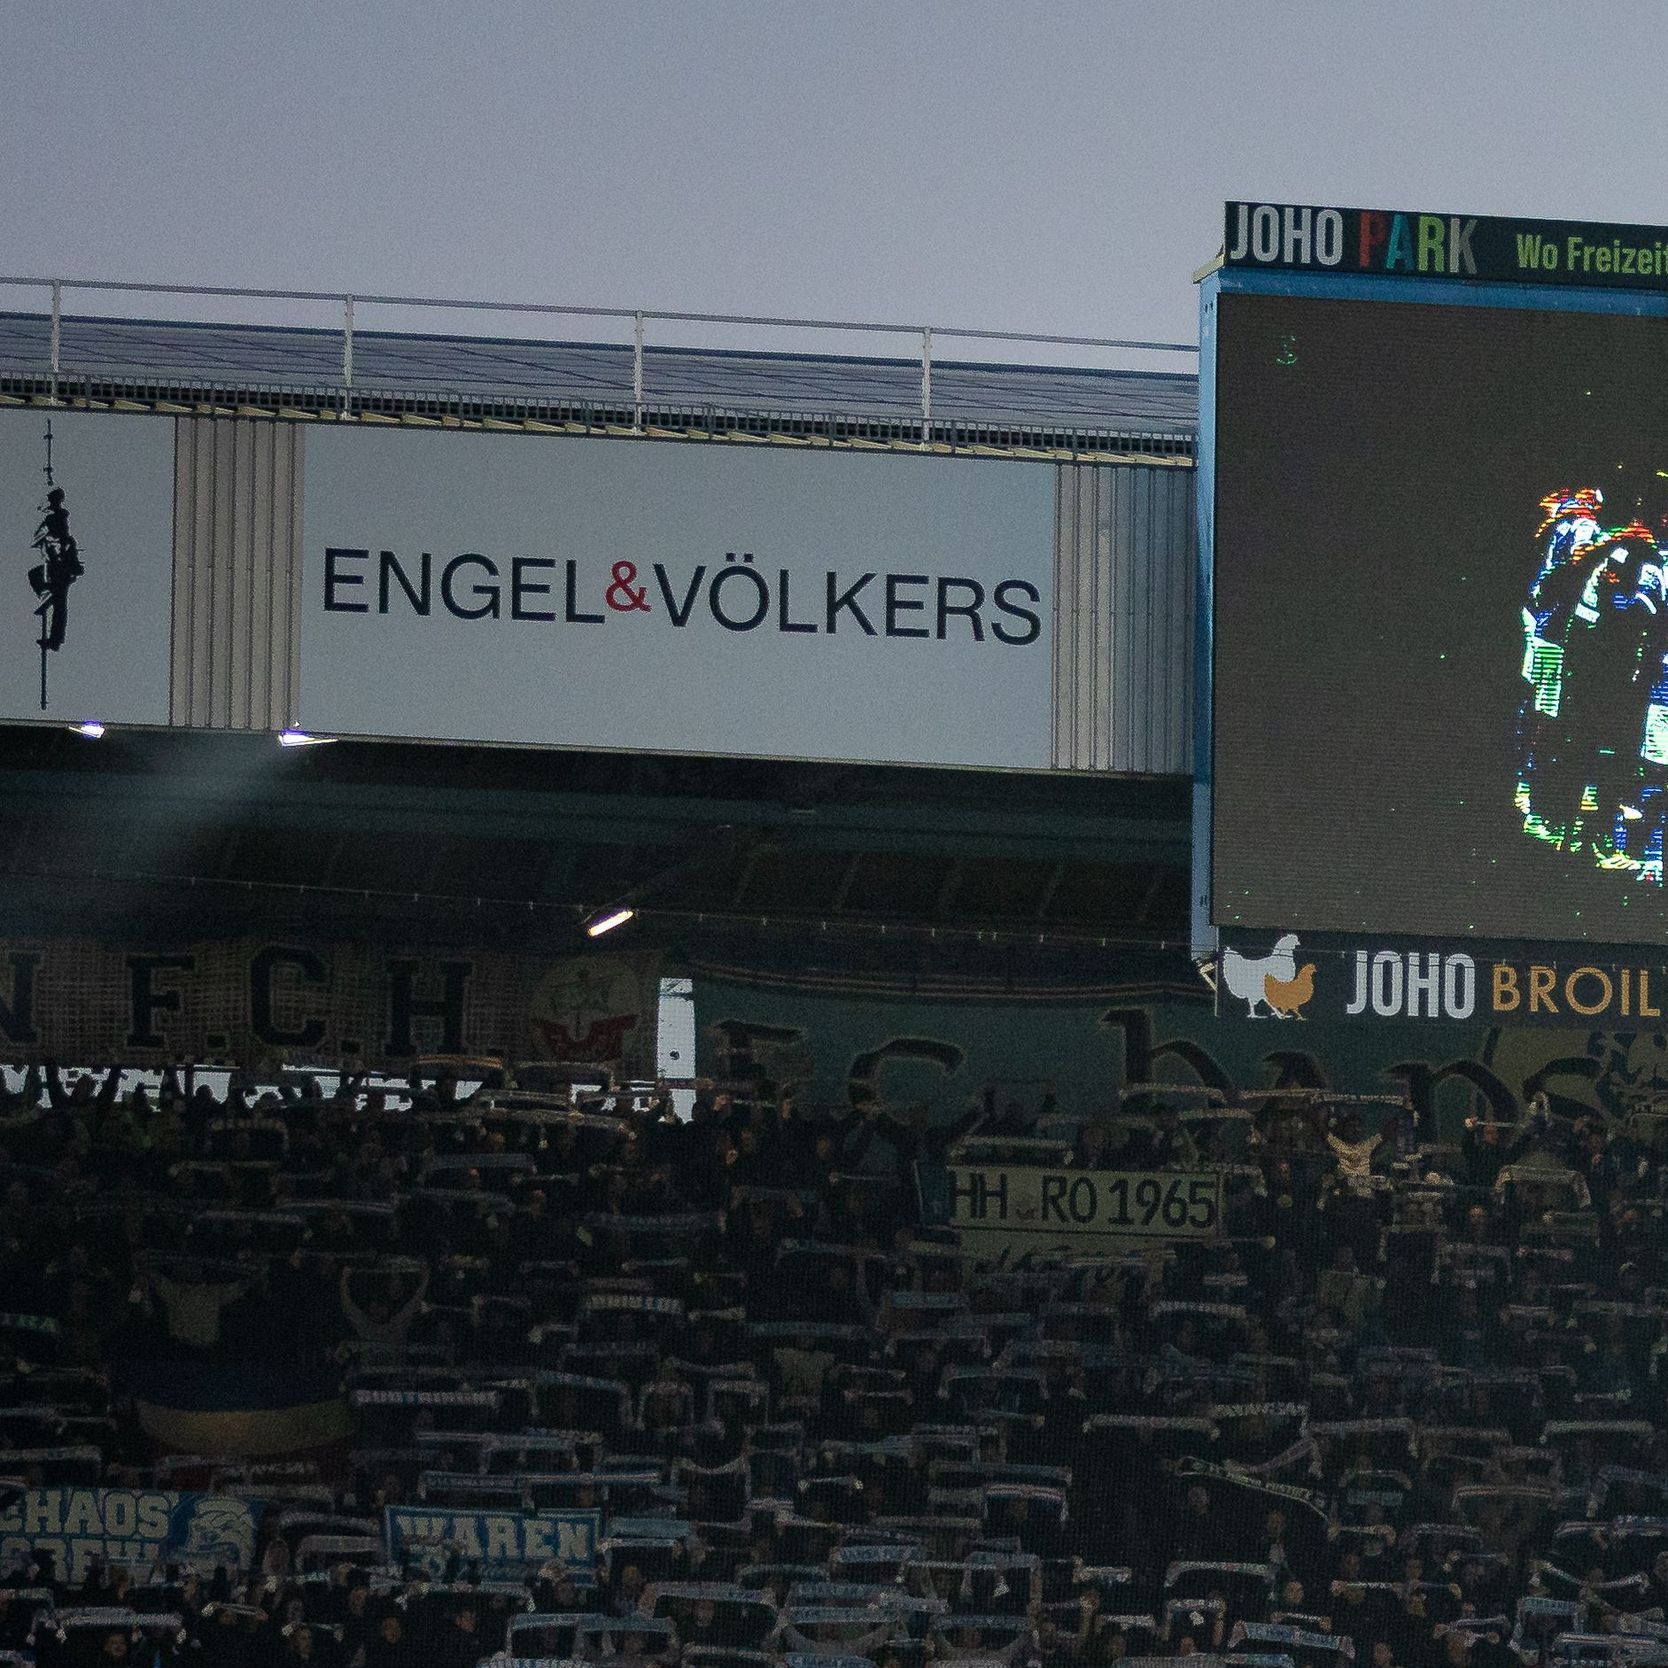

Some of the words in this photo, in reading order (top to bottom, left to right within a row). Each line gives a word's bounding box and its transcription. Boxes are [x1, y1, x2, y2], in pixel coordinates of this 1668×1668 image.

[1229, 204, 1343, 266] JOHO
[1359, 212, 1478, 274] PARK
[1516, 233, 1558, 270] Wo
[323, 547, 1042, 646] ENGEL&VÖLKERS
[1347, 950, 1475, 1019] JOHO
[1041, 1174, 1098, 1226] RO
[1107, 1178, 1218, 1229] 1965
[395, 1513, 589, 1560] WAREN
